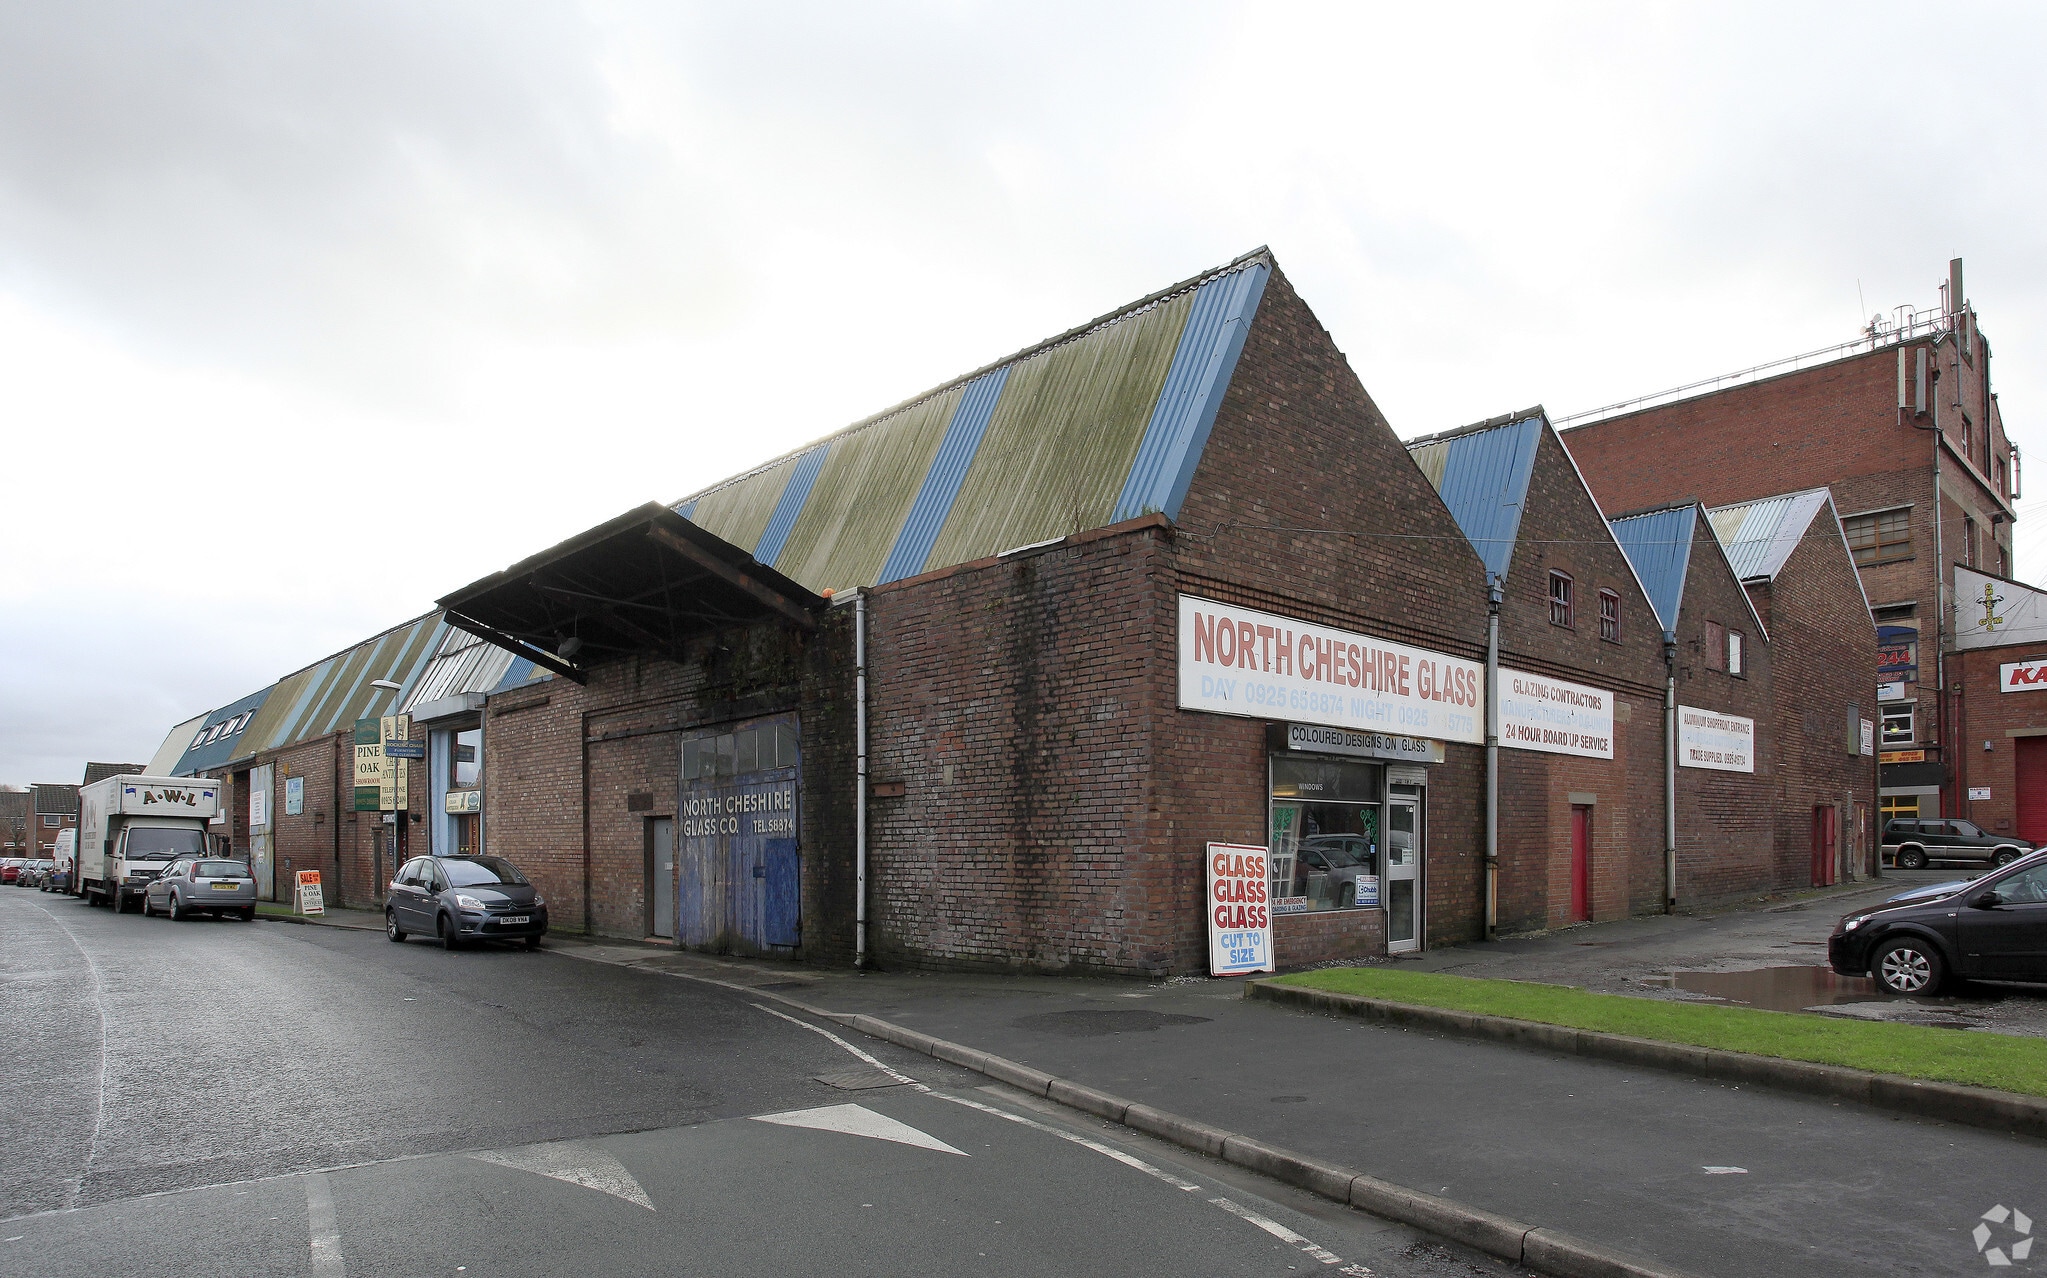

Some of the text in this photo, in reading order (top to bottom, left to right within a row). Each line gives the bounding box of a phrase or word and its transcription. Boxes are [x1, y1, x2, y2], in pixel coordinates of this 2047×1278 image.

[1194, 612, 1477, 708] NORTH CHESHIRE GLASS
[1201, 675, 1237, 701] DAY
[1245, 682, 1287, 708] 0925
[1290, 688, 1344, 716] 658874
[1350, 697, 1394, 721] NIGHT
[1398, 705, 1429, 727] 0925
[1513, 678, 1602, 711] GLAZING CONTRACTORS
[1684, 713, 1707, 728] ALUMINIUM
[1730, 721, 1750, 735] ENTRANCE
[1291, 726, 1426, 753] COLOURED DESIGNS ON GLASS
[1505, 723, 1608, 752] 24 HOUR BOARD UP SERVICE
[357, 746, 380, 758] PINE
[1689, 748, 1703, 762] TRADE
[360, 762, 380, 774] OAK
[1298, 783, 1324, 791] WINDOWS
[683, 790, 791, 817] NORTH CHESHIRE
[684, 818, 716, 837] GLASS
[720, 816, 739, 835] CO.
[1213, 853, 1265, 878] GLASS
[300, 873, 313, 883] SALE
[1214, 879, 1267, 904] GLASS
[1284, 897, 1307, 905] EMERGENCY
[1214, 905, 1268, 929] GLASS
[1221, 932, 1260, 949] CUT TO
[1230, 947, 1255, 964] SIZE
